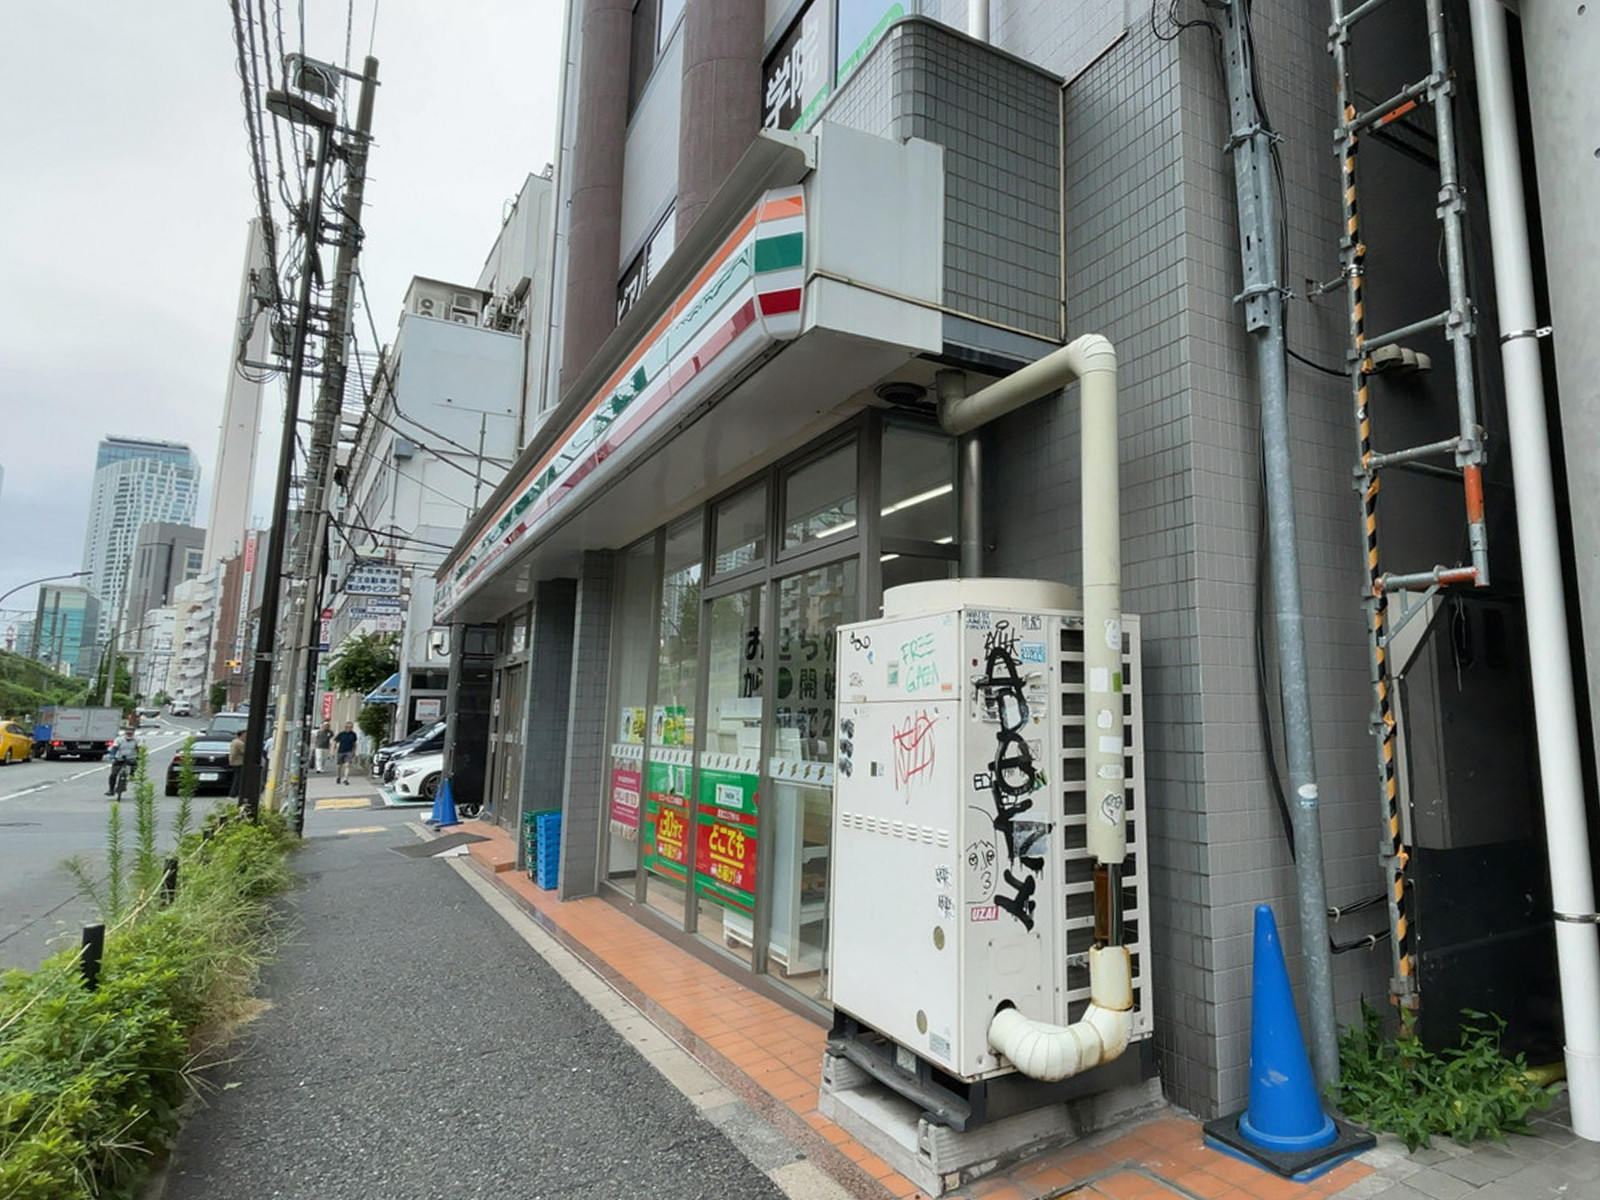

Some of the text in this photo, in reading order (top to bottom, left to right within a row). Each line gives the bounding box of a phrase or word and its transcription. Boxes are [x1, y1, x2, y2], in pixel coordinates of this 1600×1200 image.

[900, 632, 936, 664] FREE
[708, 822, 746, 860] どこでも
[972, 907, 995, 920] UZAI
